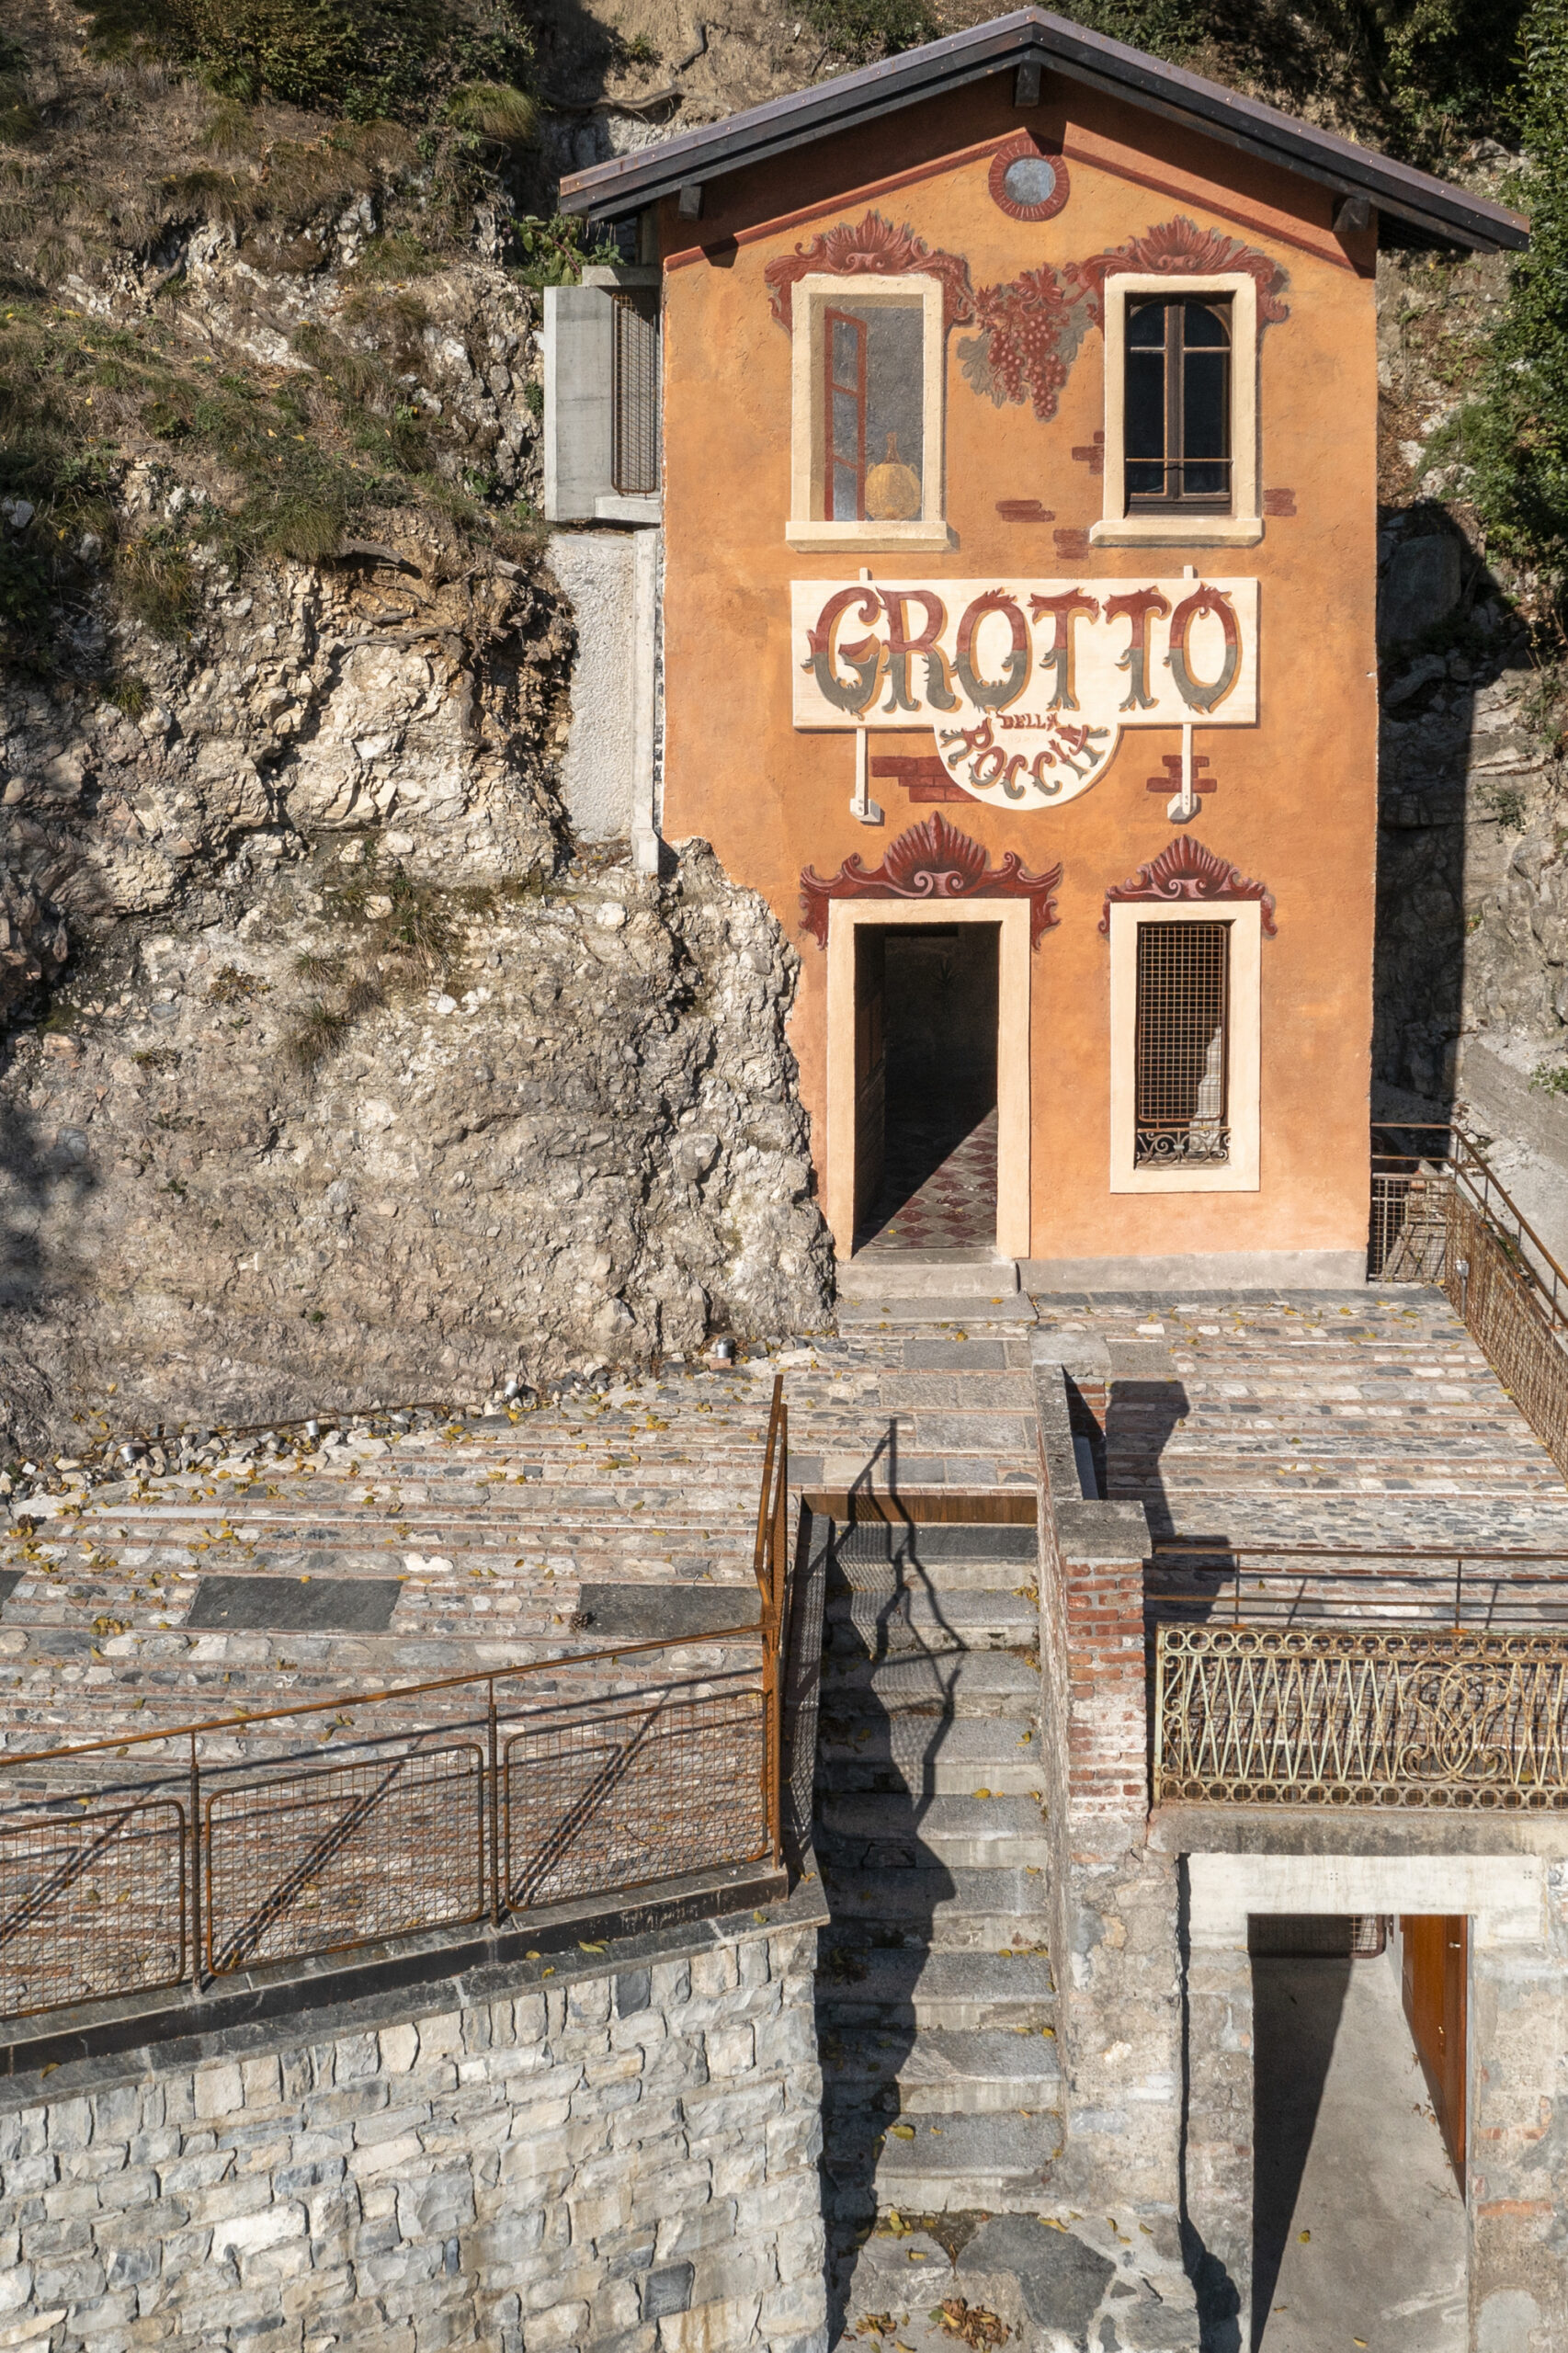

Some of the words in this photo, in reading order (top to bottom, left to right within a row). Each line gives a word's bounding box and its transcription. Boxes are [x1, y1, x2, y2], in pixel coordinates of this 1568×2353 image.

[801, 581, 1244, 721] GROTTO
[940, 717, 1110, 800] ROCCIA
[997, 712, 1059, 731] DELLA
